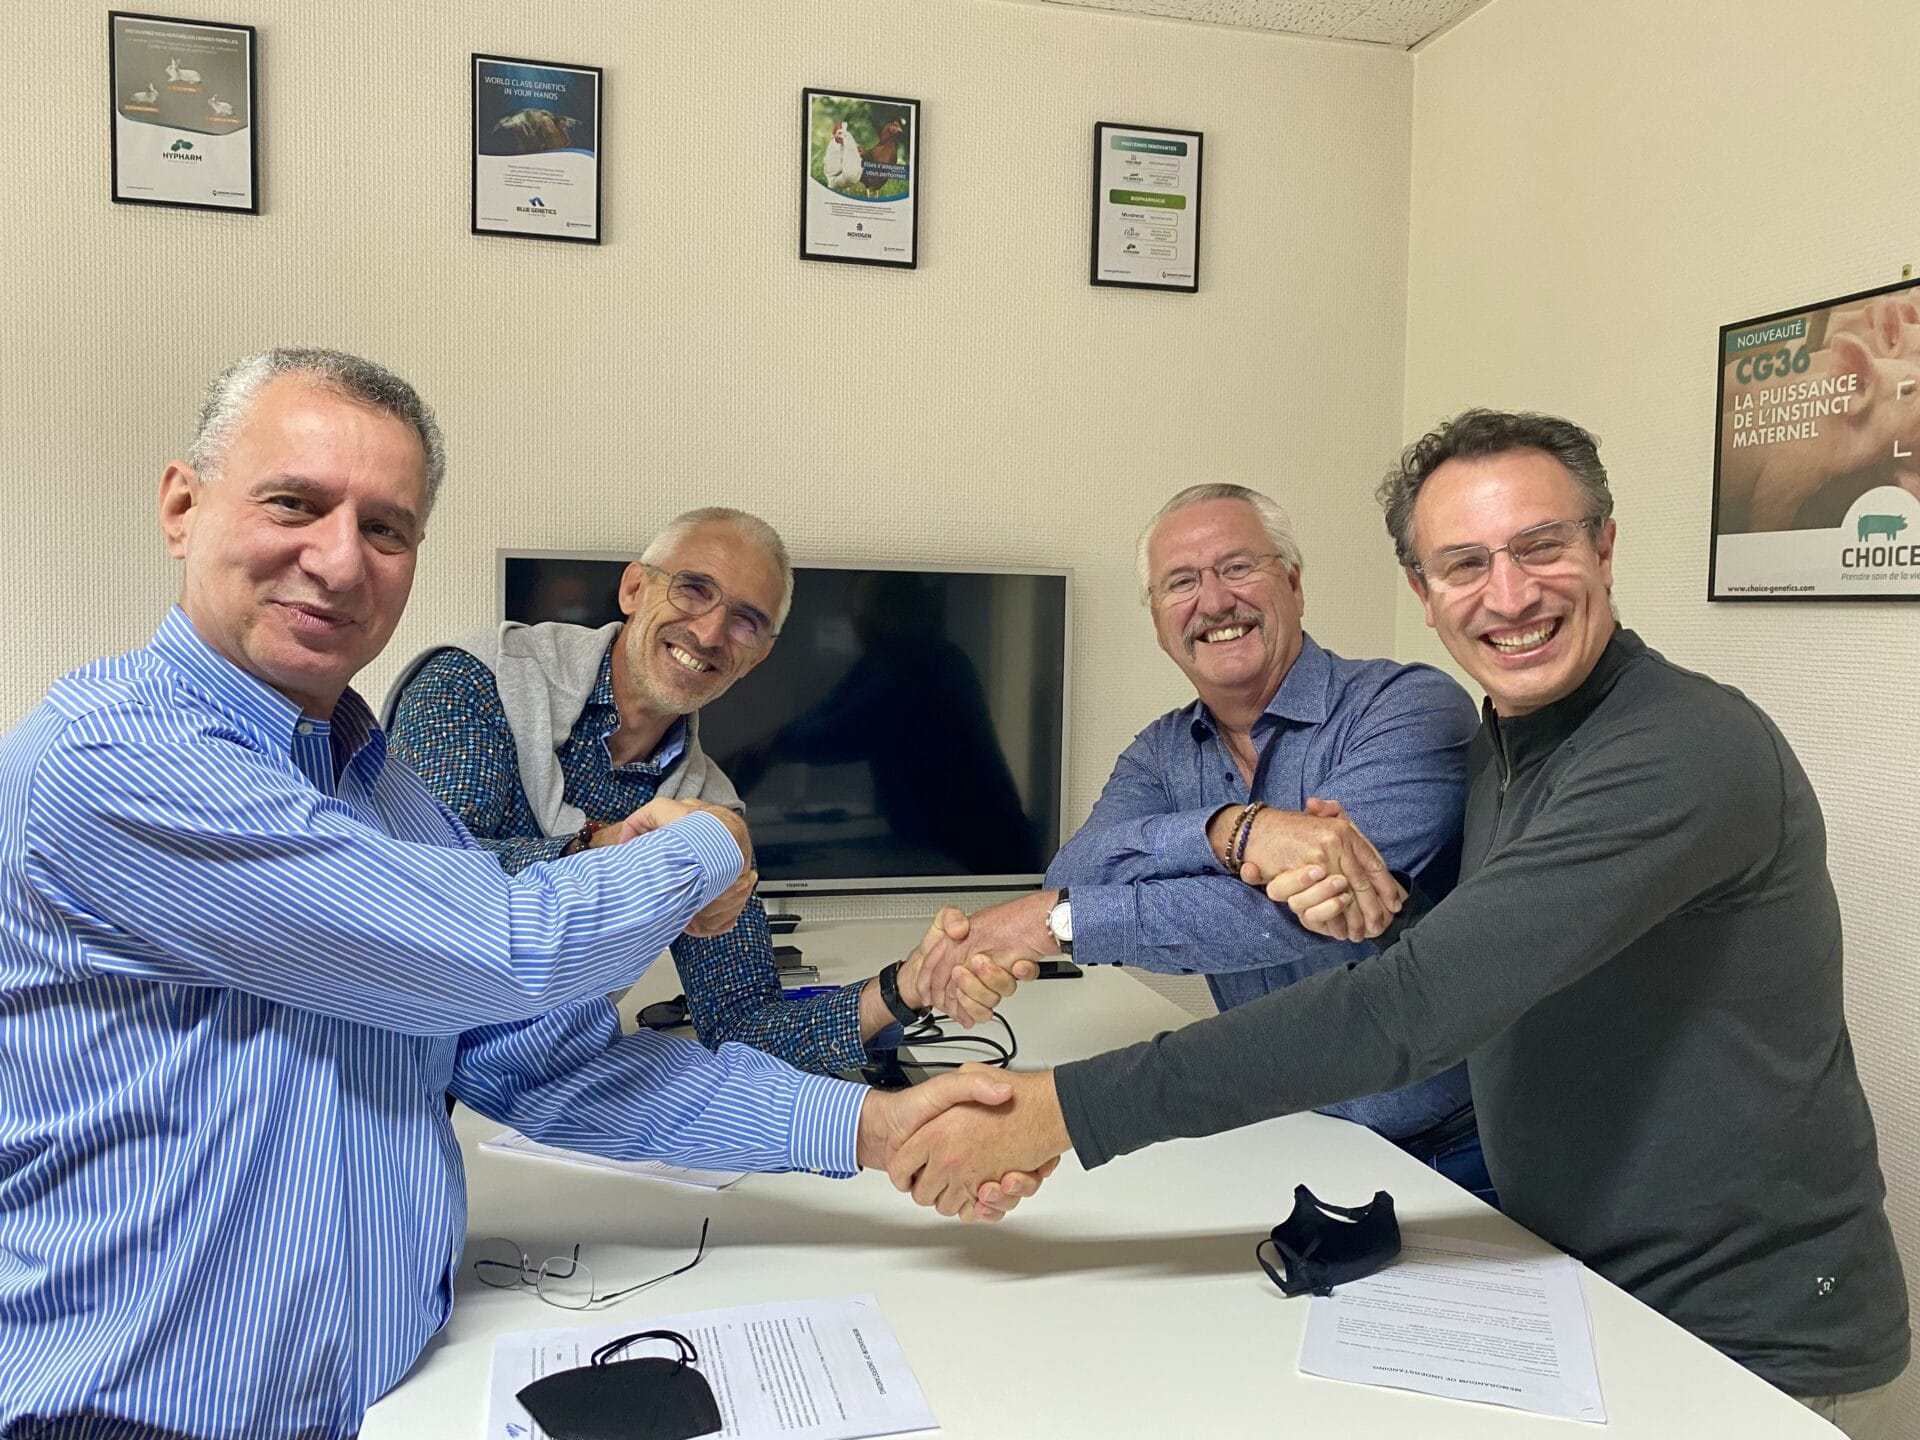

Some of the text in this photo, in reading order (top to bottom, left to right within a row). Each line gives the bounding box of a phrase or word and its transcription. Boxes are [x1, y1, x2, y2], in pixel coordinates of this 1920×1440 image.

[484, 76, 566, 92] WORLD CLASS GENETICS
[513, 89, 532, 97] YOUR
[533, 91, 558, 100] HANDS
[162, 152, 203, 162] HYPHARM
[531, 207, 557, 215] GENETICS
[847, 231, 872, 239] NOVOGEN
[1737, 320, 1802, 348] NOUVEAUTÉ
[1736, 345, 1811, 384] CG36
[1735, 373, 1858, 411] LA PUISSANCE
[1733, 395, 1852, 429] DE L'INSTINCT
[1732, 421, 1819, 448] MATERNEL
[1842, 545, 1920, 568] CHOICE
[1841, 573, 1870, 581] Prendre
[1888, 571, 1899, 580] de
[1901, 571, 1908, 580] la
[1727, 584, 1815, 593] www.choice-genetics.com
[852, 1328, 869, 1354] MEMORANDUM
[866, 1360, 887, 1395] UNDERSTANDING
[1372, 1365, 1444, 1381] UNDERSTANDING
[1458, 1379, 1522, 1393] MEMORANDUM
